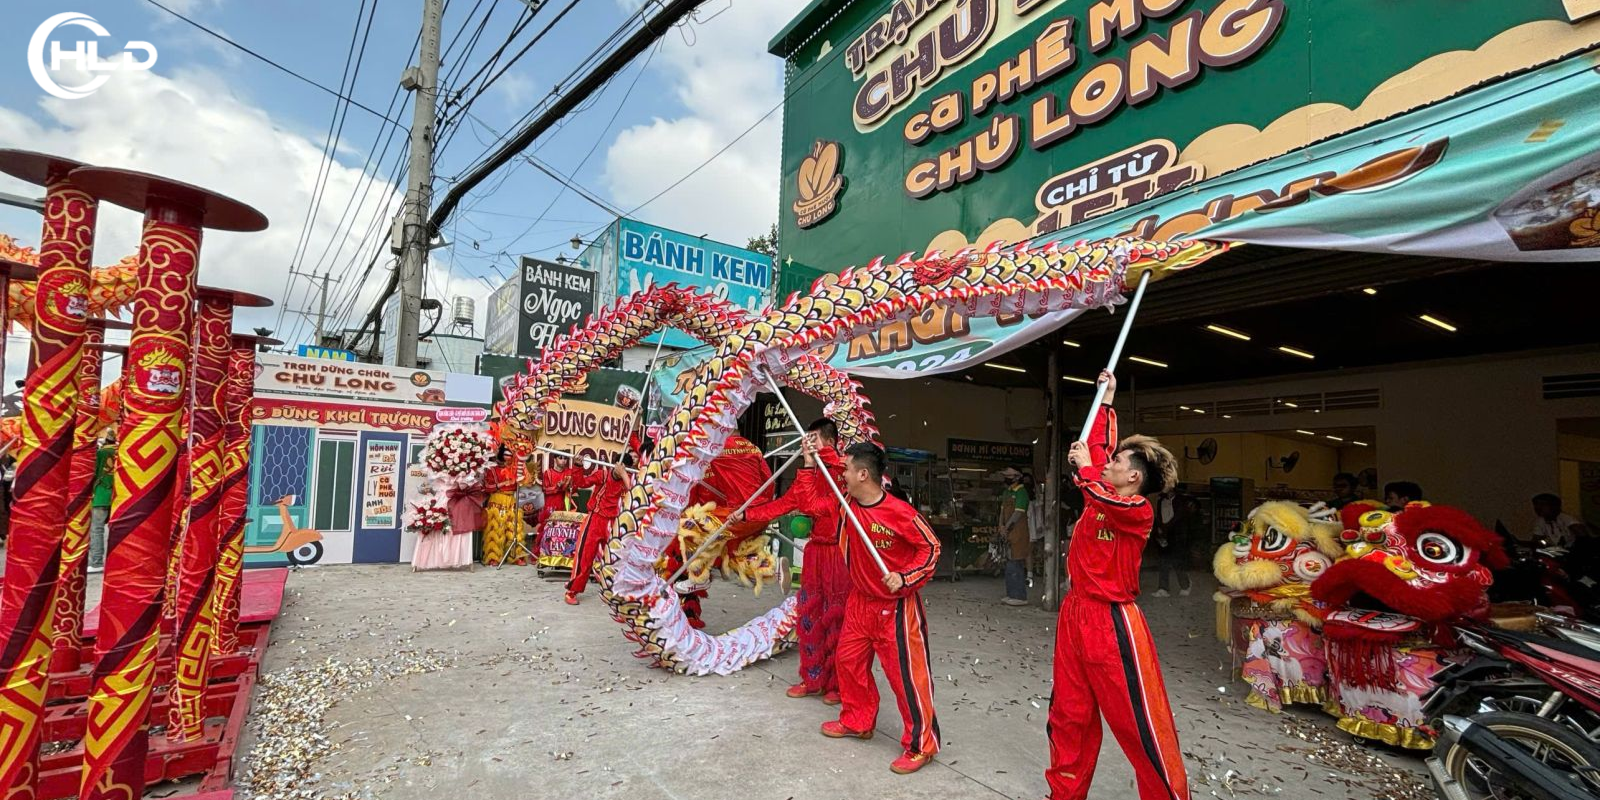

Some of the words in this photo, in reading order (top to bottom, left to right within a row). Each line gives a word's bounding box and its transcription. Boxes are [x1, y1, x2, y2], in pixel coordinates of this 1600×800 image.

[973, 18, 1074, 113] PHÊ
[905, 116, 1018, 196] CHÚ
[1033, 0, 1273, 142] LONG
[1047, 166, 1098, 206] CHỈ
[1107, 151, 1158, 183] TỪ
[813, 201, 833, 219] LONG
[625, 231, 704, 276] BÁNH
[712, 252, 768, 289] KEM
[525, 263, 562, 287] BÁNH
[565, 274, 590, 293] KEM
[524, 287, 581, 323] Ngọc
[275, 371, 324, 386] CHÚ
[335, 377, 397, 391] LONG
[369, 411, 432, 428] TRƯƠNG
[546, 404, 597, 437] DỪNG
[366, 499, 383, 508] ANH
[547, 526, 576, 539] HUỲNH
[550, 540, 565, 551] LÂN
